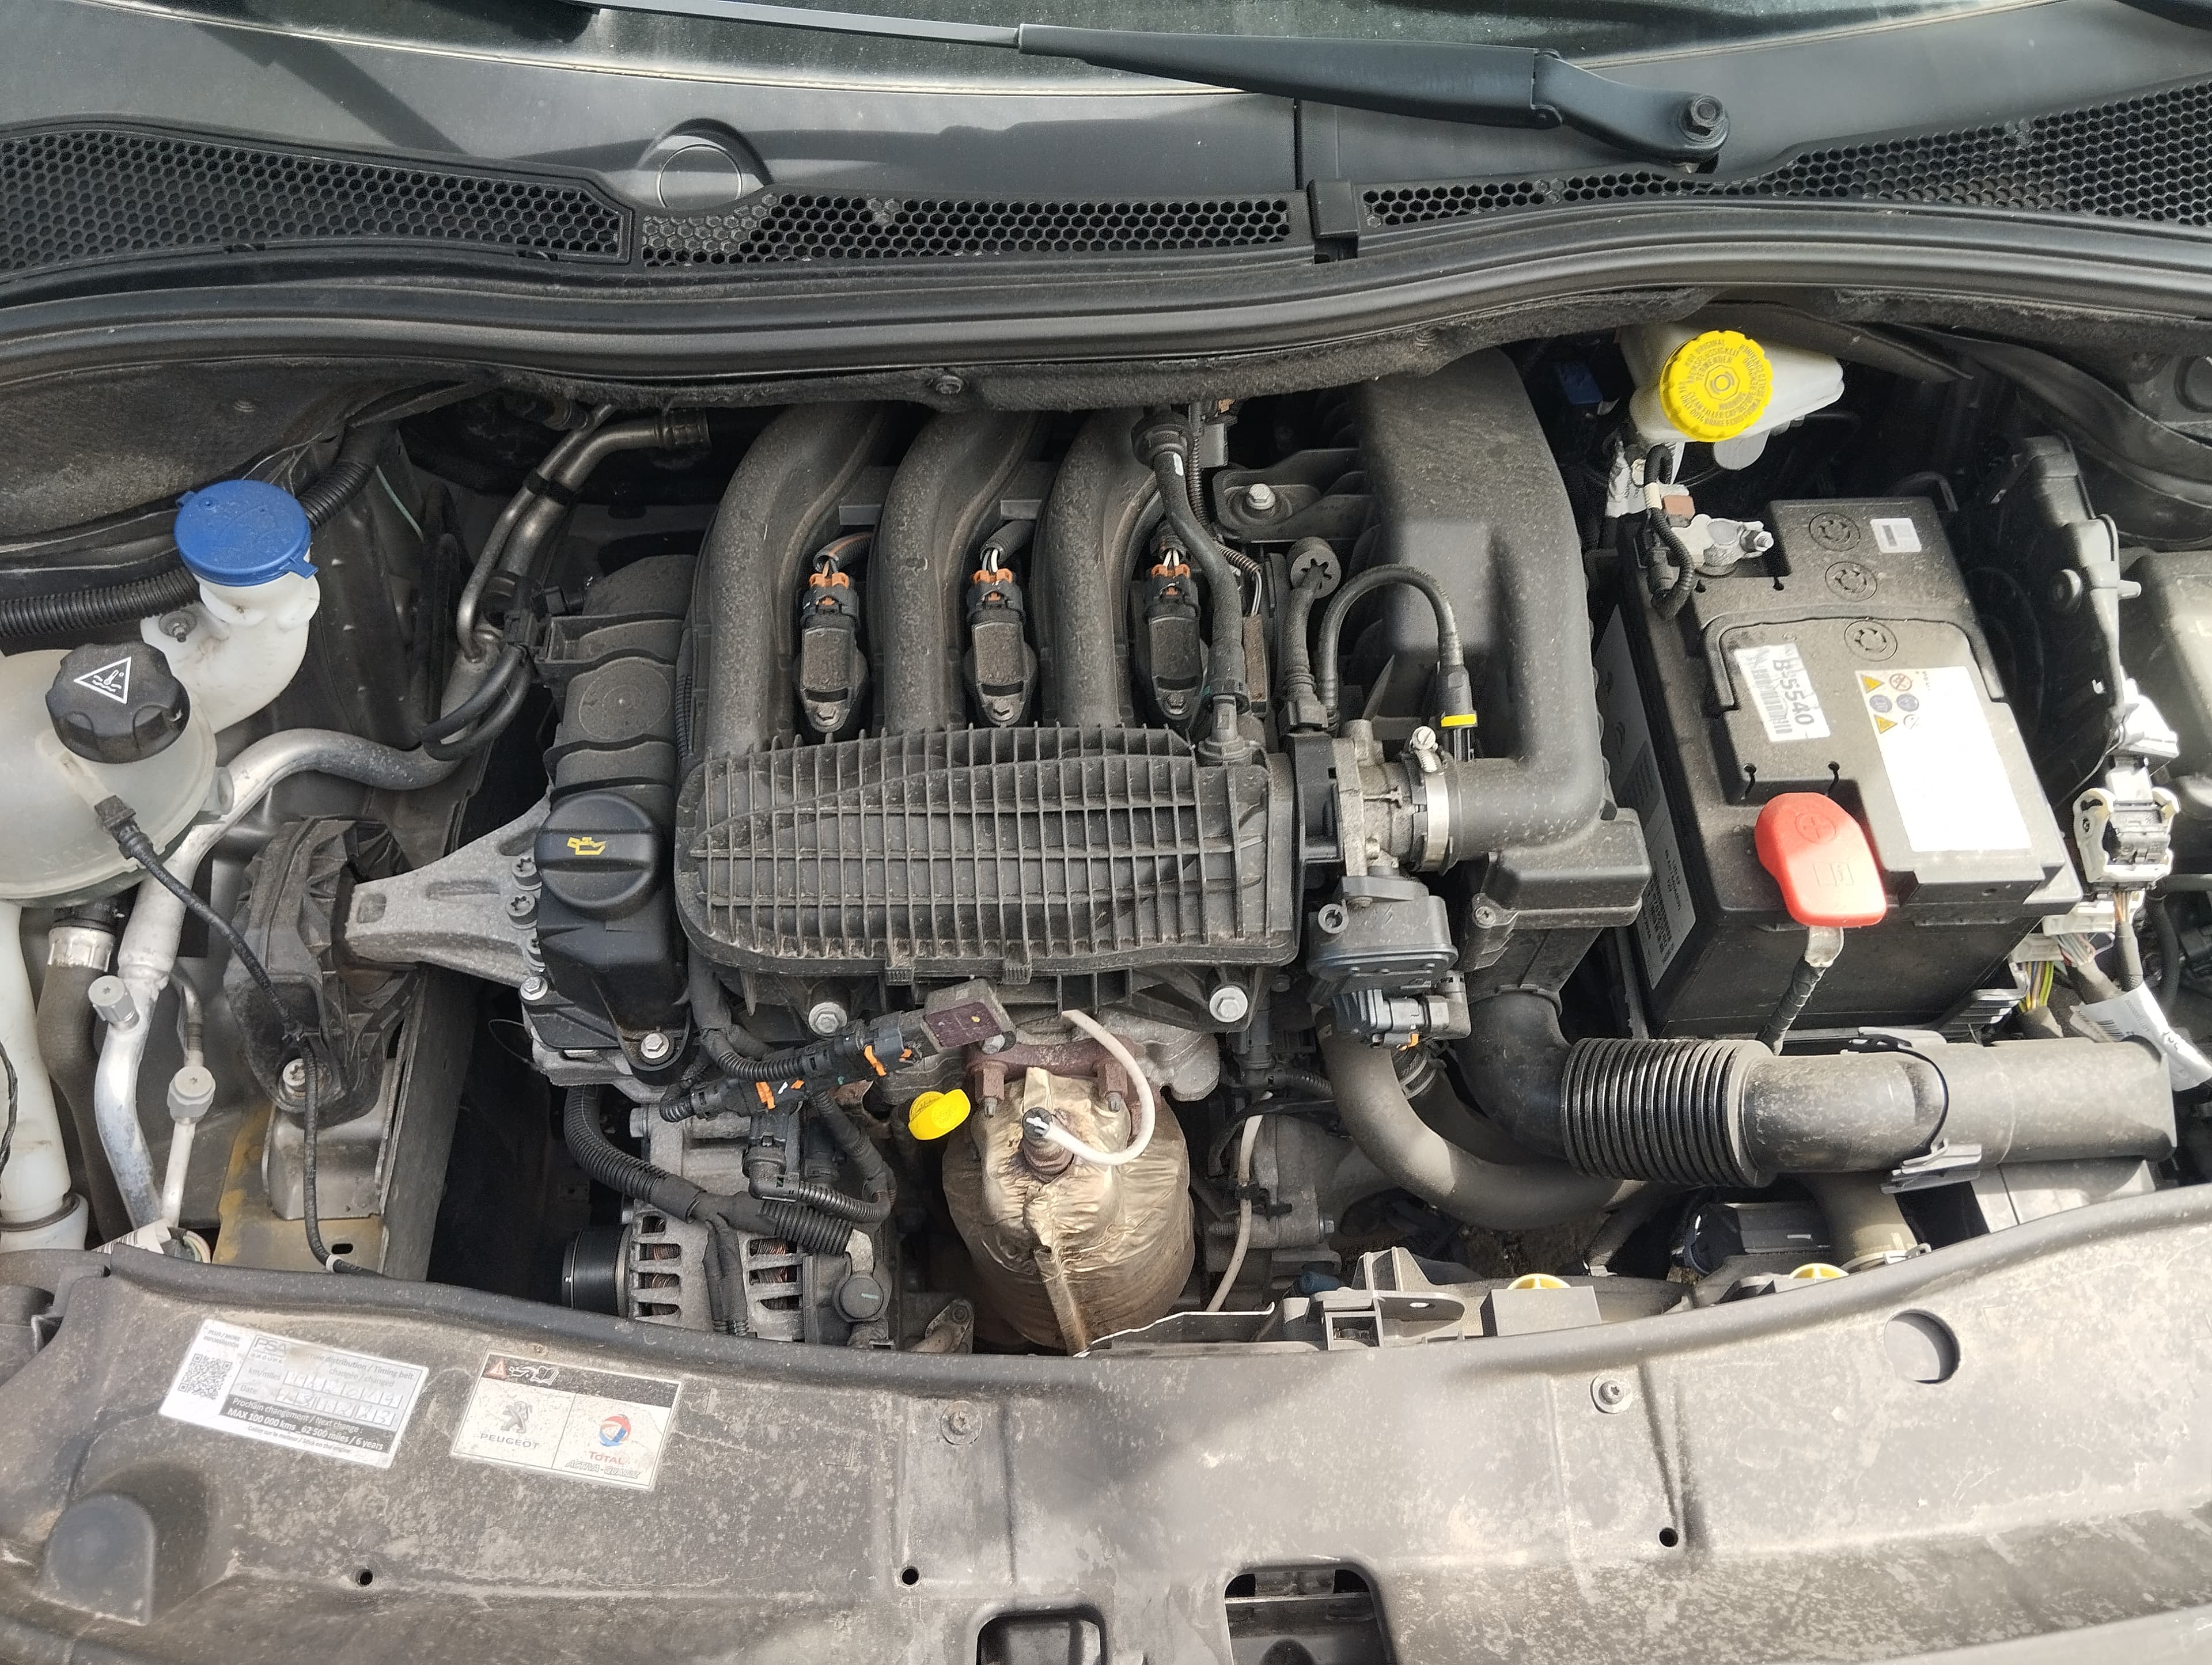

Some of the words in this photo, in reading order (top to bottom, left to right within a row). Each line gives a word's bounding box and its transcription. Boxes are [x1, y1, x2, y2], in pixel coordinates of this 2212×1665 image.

[253, 1337, 287, 1355] PSA
[247, 1367, 282, 1381] km/miles
[373, 1365, 399, 1378] Timing
[397, 1370, 414, 1380] belt
[239, 1384, 259, 1394] Date
[363, 1375, 395, 1389] changed
[232, 1397, 265, 1411] Prochain
[263, 1405, 310, 1423] changement
[315, 1416, 333, 1427] Next
[332, 1420, 360, 1434] change
[226, 1408, 248, 1419] MAX
[247, 1412, 264, 1423] 100
[262, 1416, 280, 1427] 000
[312, 1427, 328, 1438] 500
[327, 1431, 350, 1443] miles
[355, 1437, 362, 1445] 6
[361, 1439, 384, 1452] years
[479, 1432, 539, 1449] PEUGEOT
[565, 1458, 601, 1473] ACTIVA
[586, 1450, 626, 1466] TOTAL
